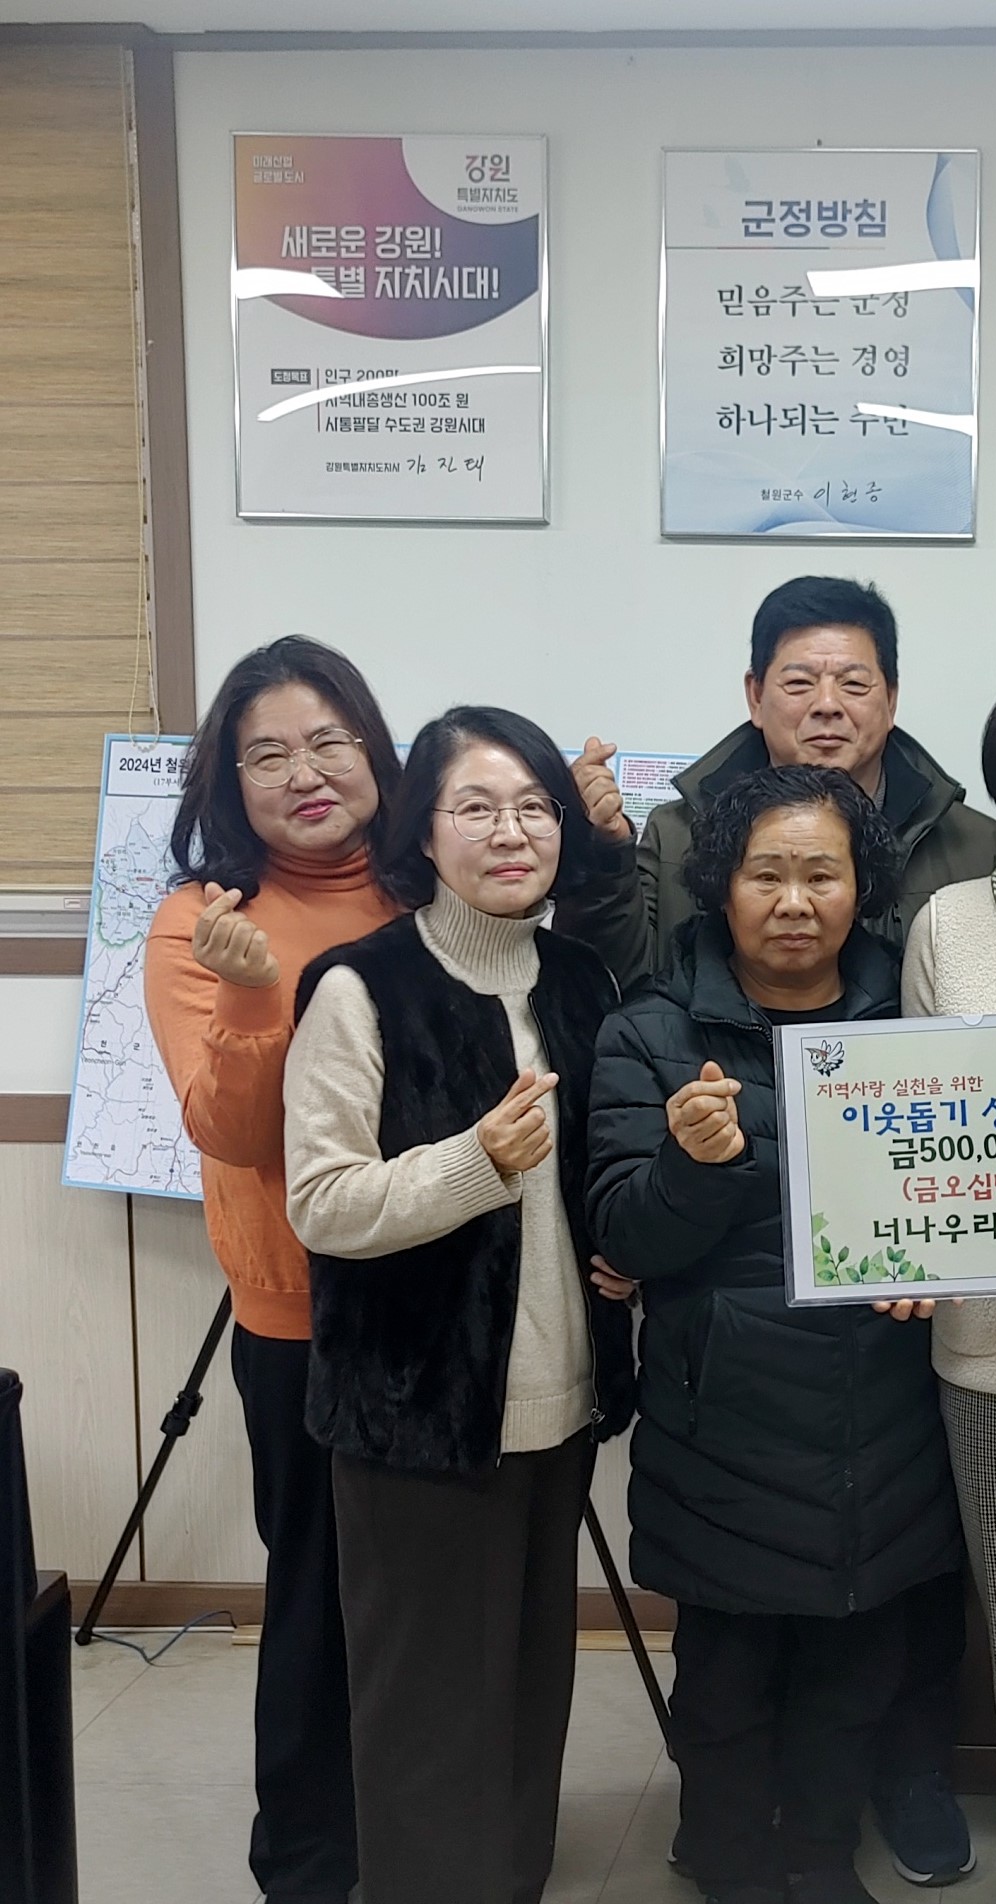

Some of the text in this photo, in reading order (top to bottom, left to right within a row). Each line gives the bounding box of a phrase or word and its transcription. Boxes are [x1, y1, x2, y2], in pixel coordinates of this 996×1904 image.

[465, 153, 511, 184] 강원
[457, 187, 518, 203] 특별자치도
[741, 198, 887, 238] 군정방침
[281, 225, 442, 259] 새로운 강원!
[374, 265, 499, 299] 자치시대!
[717, 284, 841, 319] 믿음주는
[325, 368, 351, 384] 인구
[717, 344, 910, 378] 희망주는 경영
[412, 393, 451, 408] 100조
[456, 393, 469, 409] 원
[385, 417, 425, 433] 수도권
[430, 417, 485, 434] 강원시대
[716, 403, 840, 437] 하나되는
[761, 488, 804, 501] 철원군수
[119, 757, 161, 773] 2024년
[816, 1075, 984, 1099] 지역사랑 실천을 위한
[842, 1098, 968, 1136] 이웃돕기
